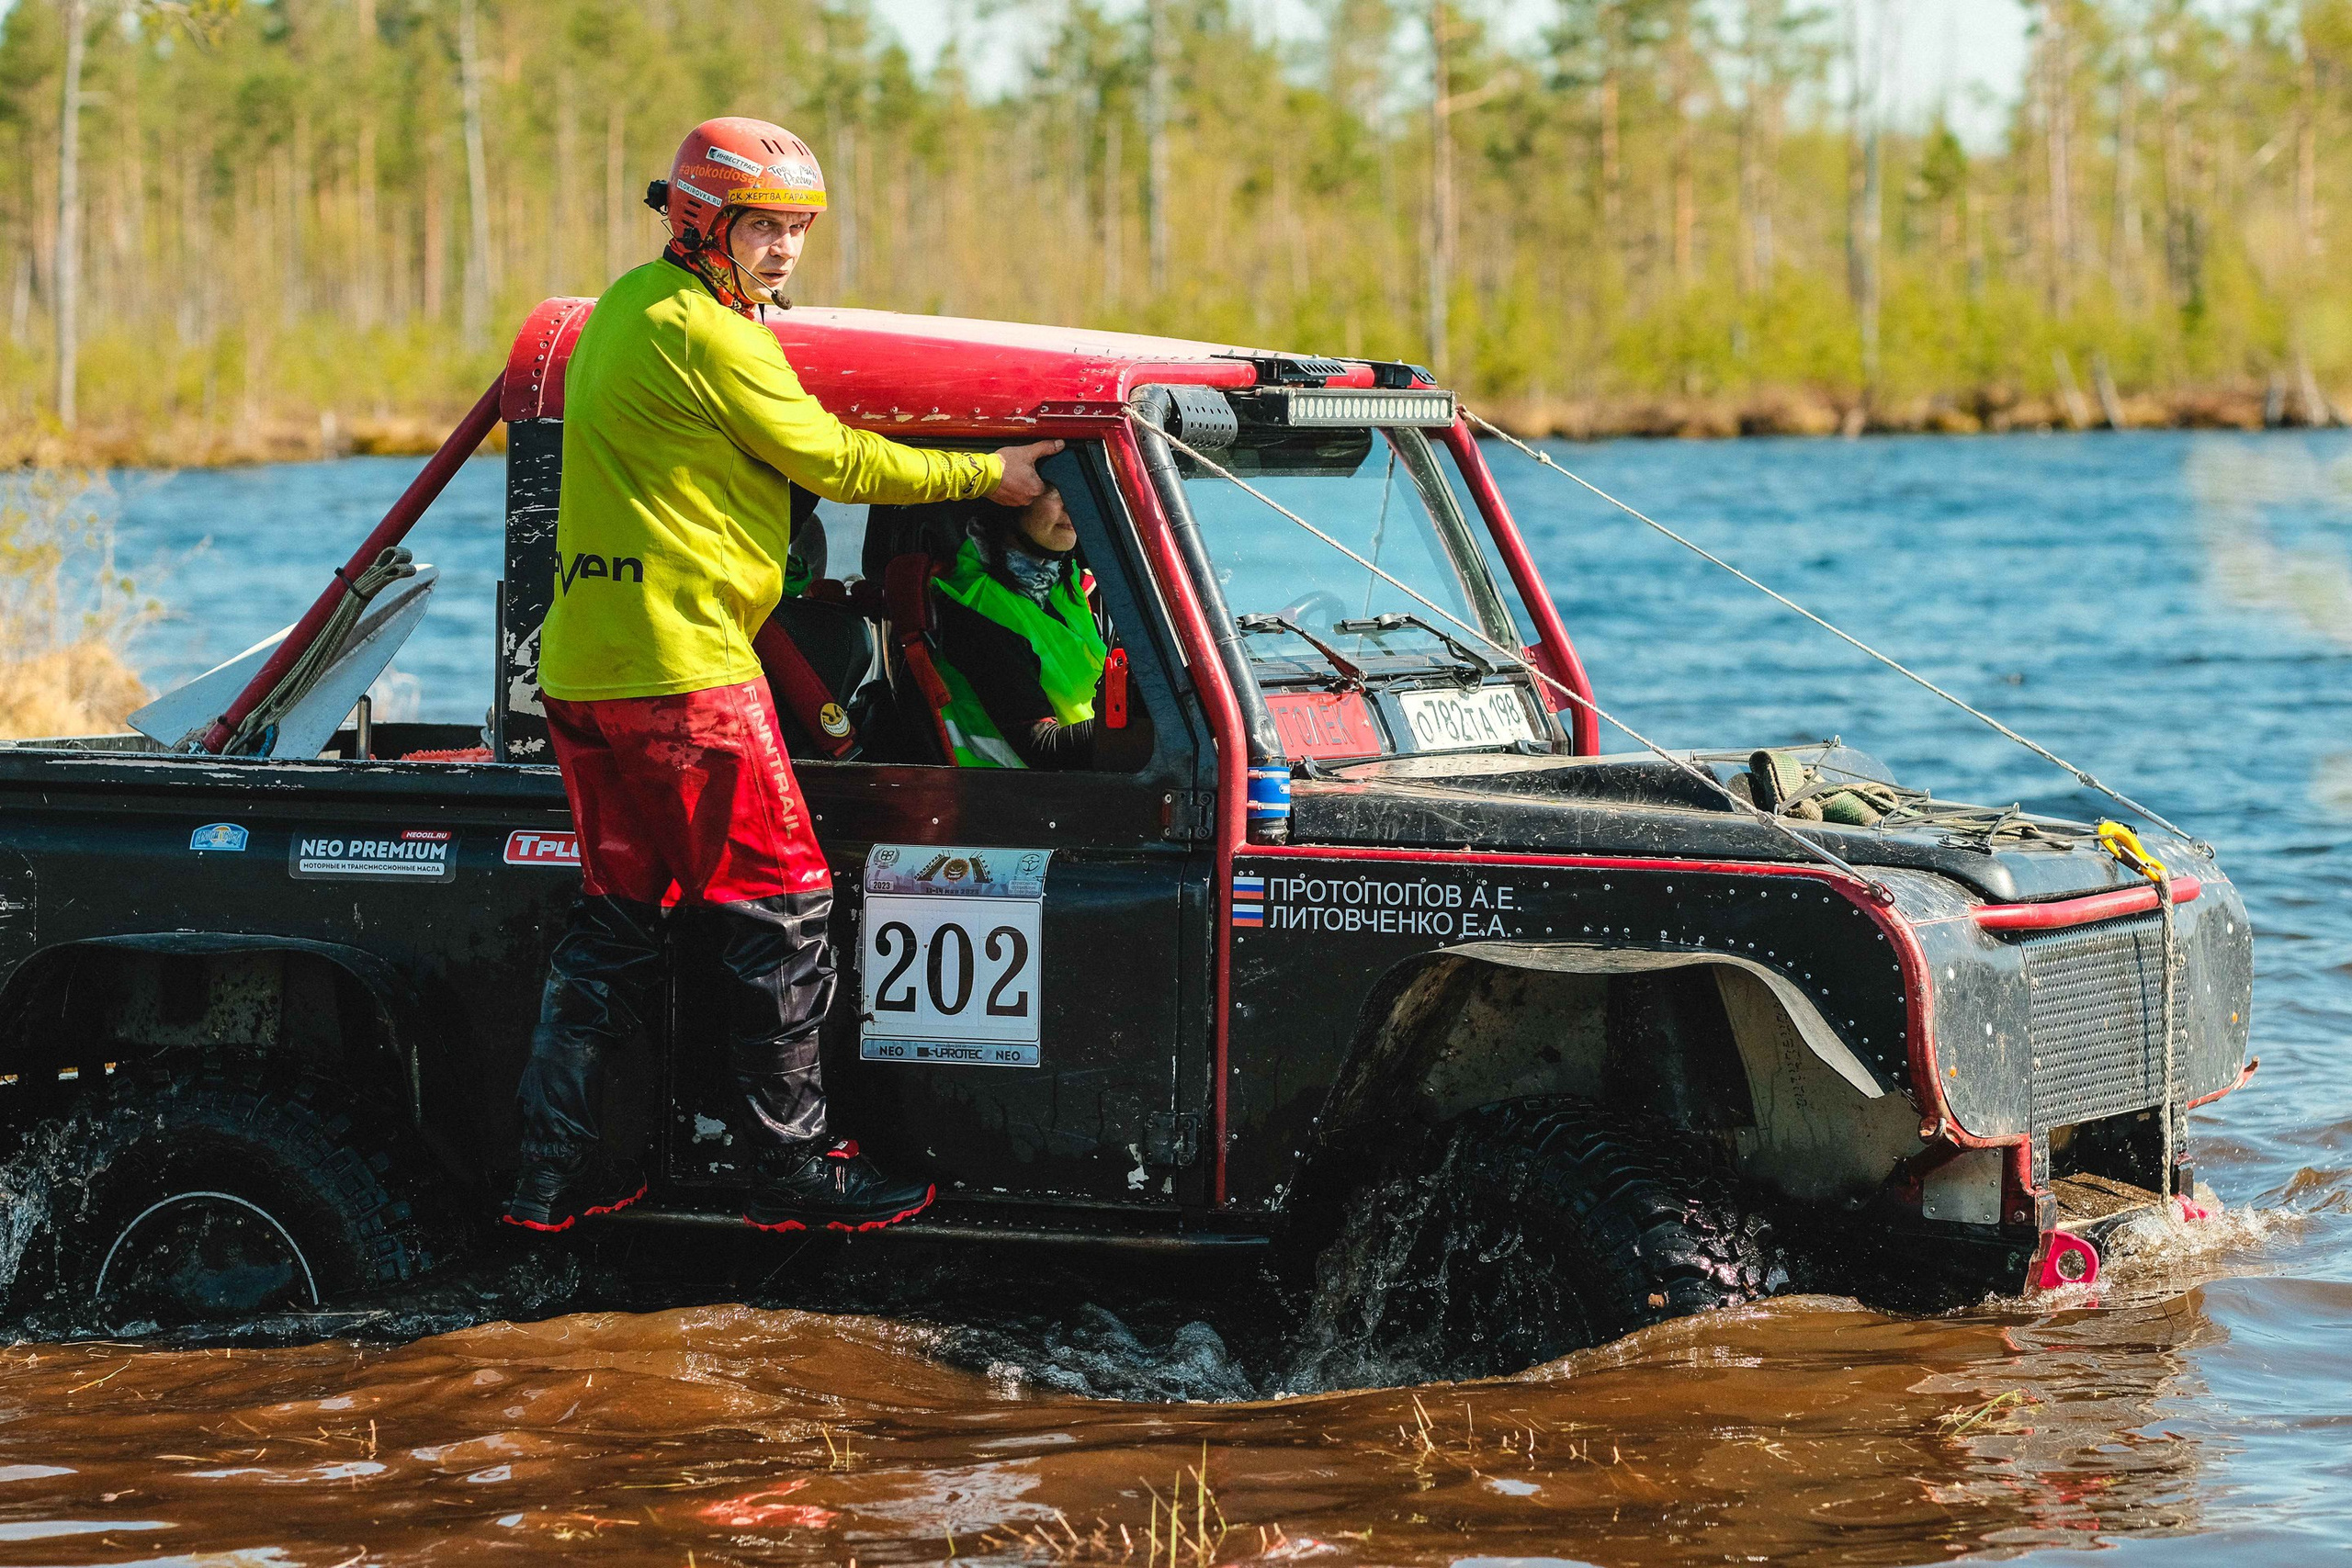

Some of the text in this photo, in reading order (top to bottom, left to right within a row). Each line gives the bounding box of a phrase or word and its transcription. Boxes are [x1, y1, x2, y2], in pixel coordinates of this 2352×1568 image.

[717, 152, 761, 173] ИНВЕСТТРАСТ
[729, 192, 742, 201] СК
[745, 192, 781, 201] ЖЕРТВА
[1488, 693, 1521, 727] 198
[741, 684, 799, 840] FINNTRAIL
[300, 839, 447, 860] NEO PREMIUM
[347, 863, 415, 872] ТРАНСМИССИОННЫЕ
[873, 881, 890, 889] 2023
[1271, 877, 1522, 910] ПРОТОПОПОВ А.Е.
[1270, 906, 1453, 935] ЛИТОВЧЕНКО
[875, 921, 1028, 1017] 202
[879, 1046, 1021, 1061] NEO SUPROTEC NEO
